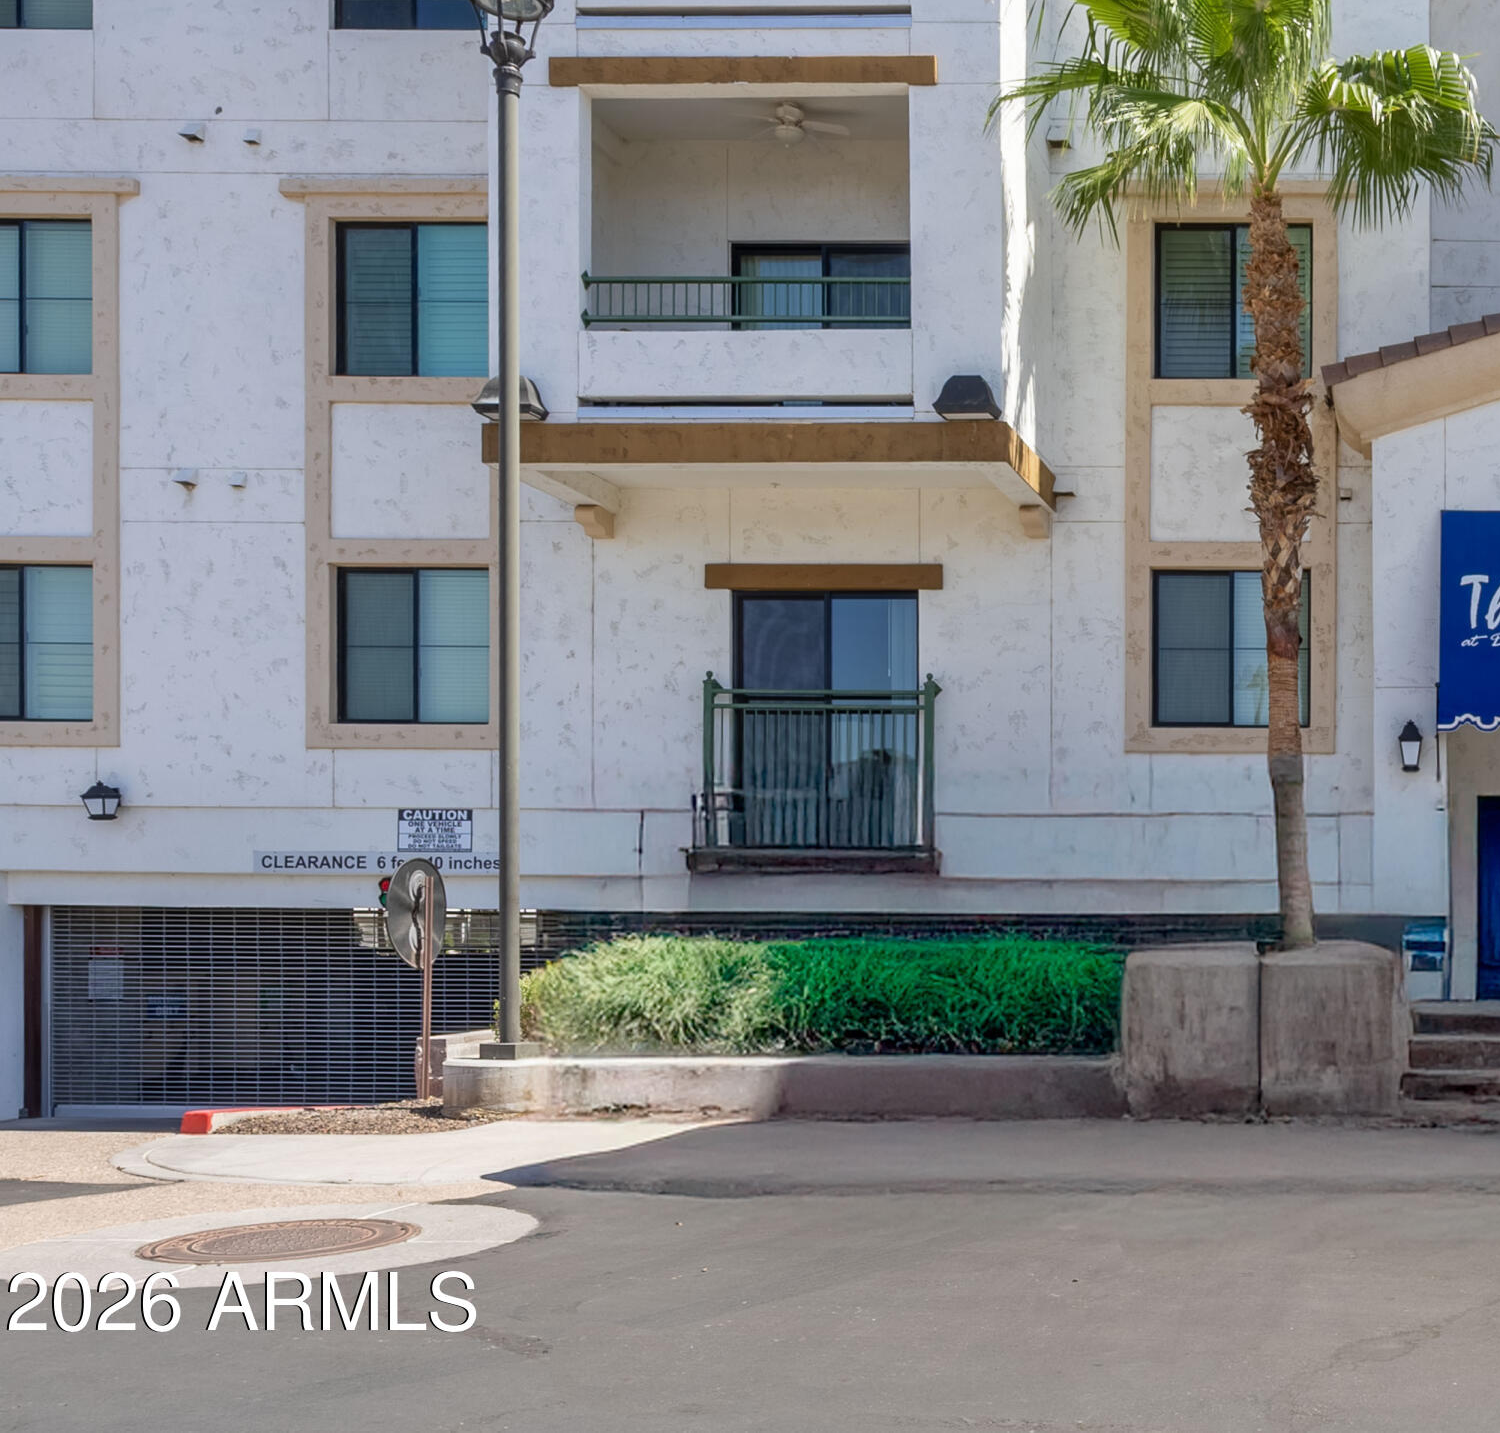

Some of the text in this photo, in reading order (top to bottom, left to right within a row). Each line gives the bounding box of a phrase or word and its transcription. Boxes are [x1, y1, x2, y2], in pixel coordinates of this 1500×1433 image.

[1461, 634, 1488, 647] at
[403, 810, 467, 820] CAUTION
[261, 855, 367, 869] CLEARANCE
[377, 856, 386, 869] 6
[448, 856, 500, 869] inches
